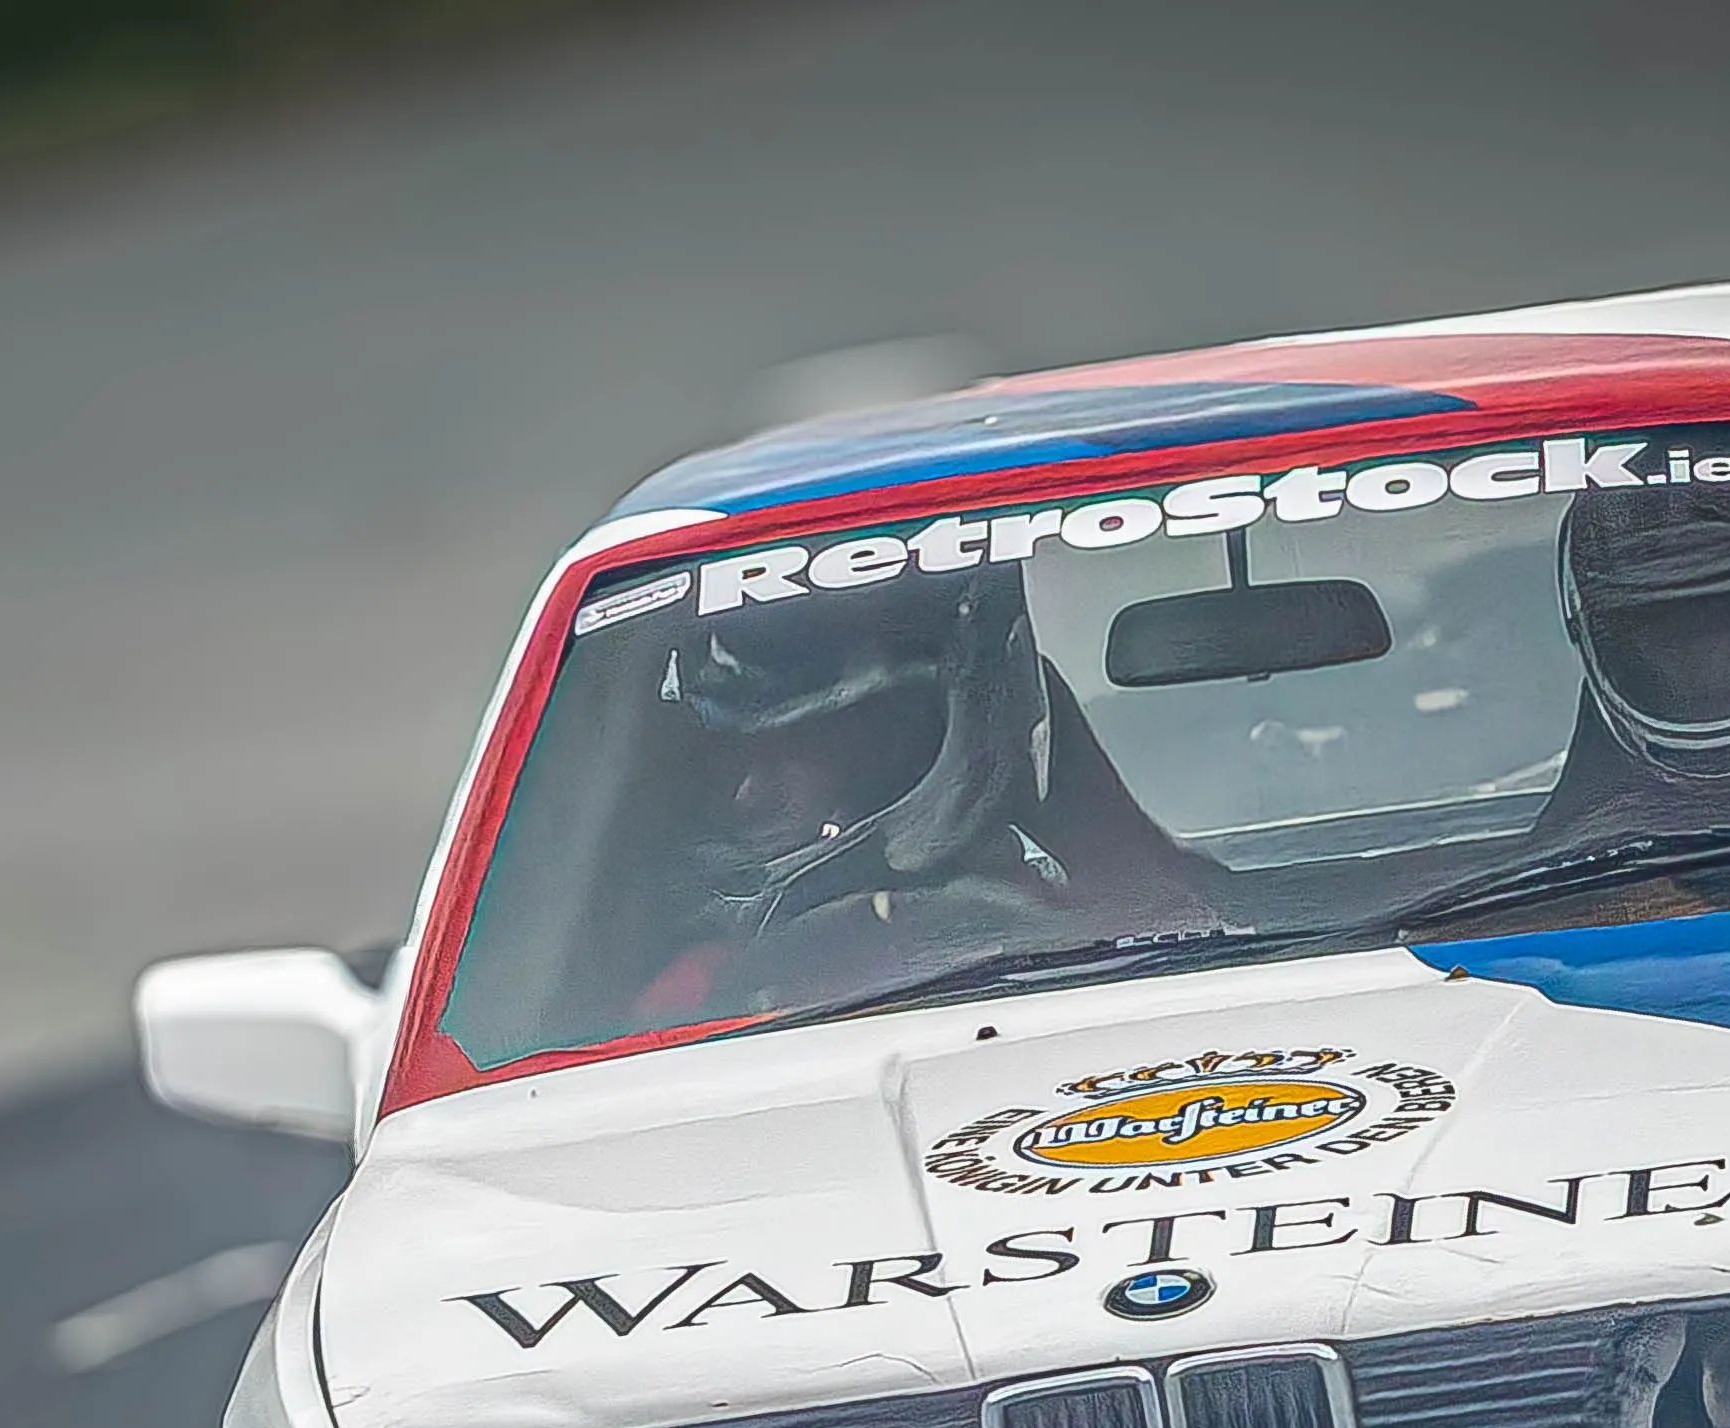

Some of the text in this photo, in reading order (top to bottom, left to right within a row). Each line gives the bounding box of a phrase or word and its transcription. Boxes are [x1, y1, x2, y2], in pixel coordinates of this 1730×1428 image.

[1350, 1062, 1457, 1114] BIEREN
[930, 1108, 1048, 1150] EINE
[1314, 1116, 1438, 1155] DEN
[1088, 1152, 1321, 1195] UNTER
